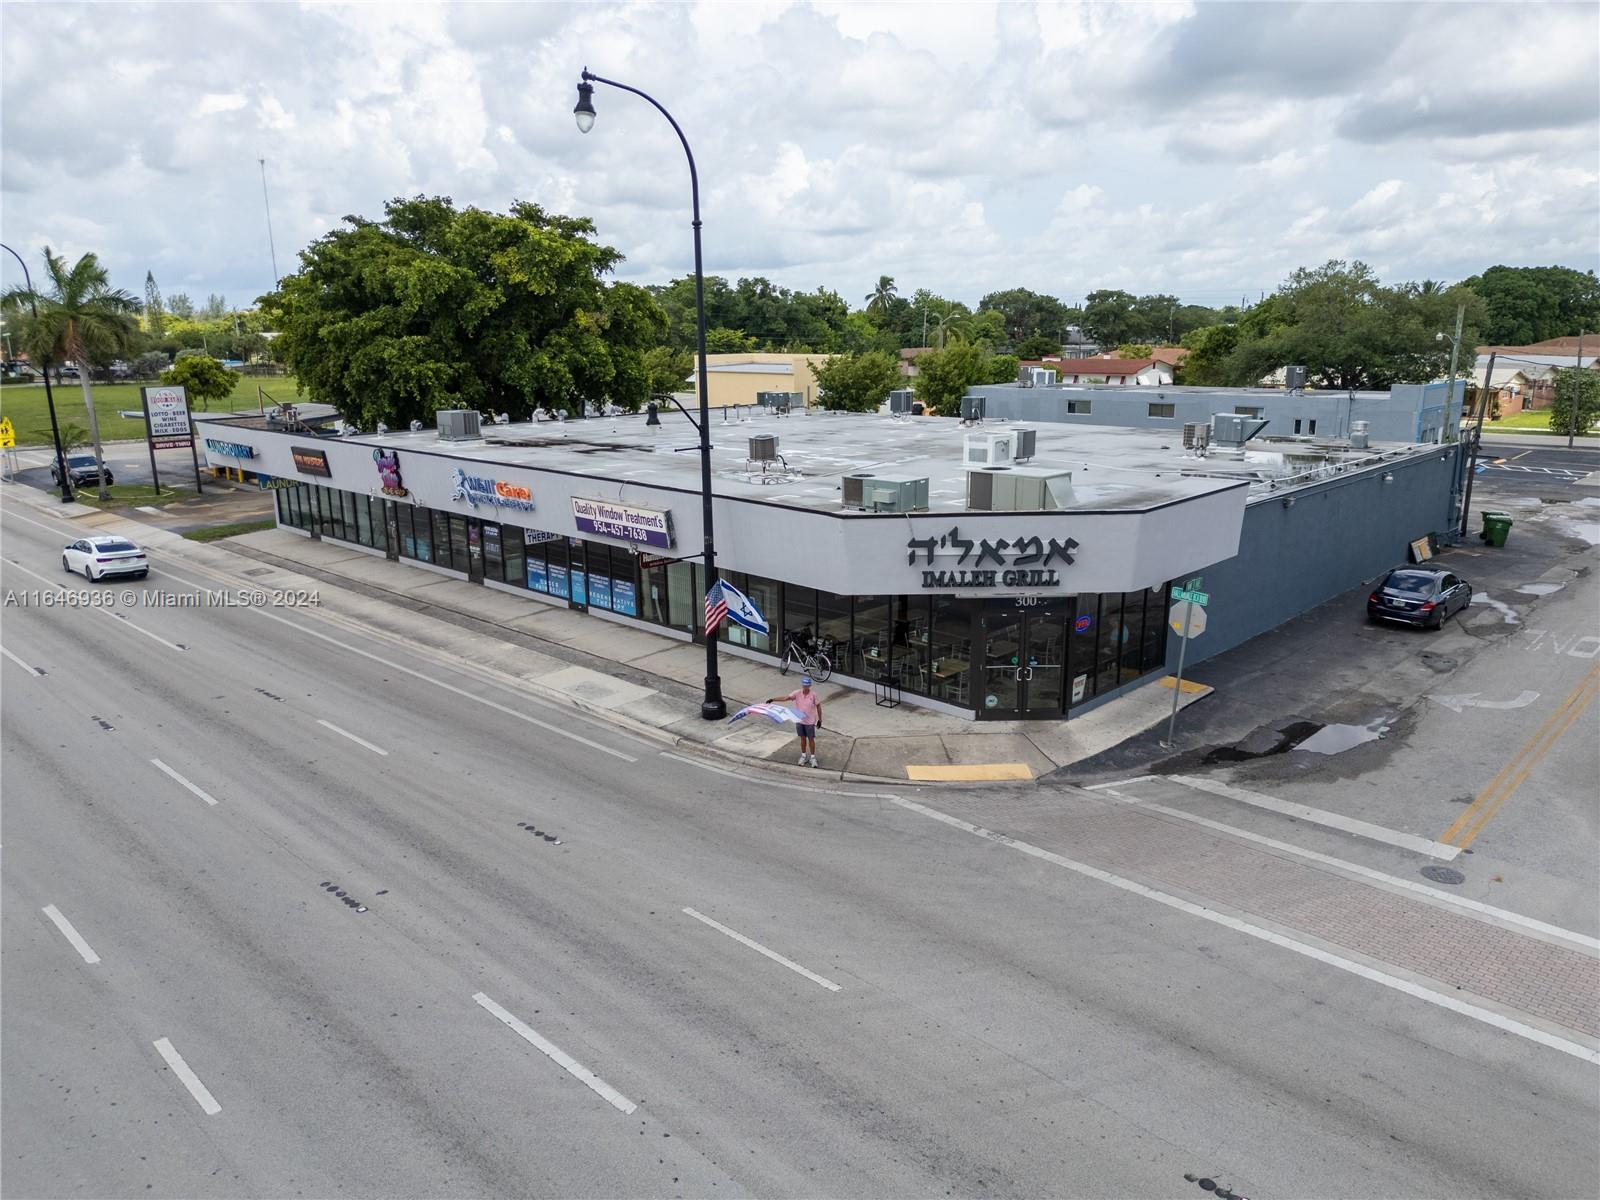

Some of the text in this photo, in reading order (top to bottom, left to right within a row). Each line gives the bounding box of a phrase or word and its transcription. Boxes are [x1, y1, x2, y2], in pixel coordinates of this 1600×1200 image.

[495, 480, 532, 502] Care
[574, 500, 664, 529] Quality Window Treatment's
[593, 520, 648, 541] 954-457-7638
[921, 569, 1060, 588] IMALEH GRILL
[1015, 596, 1037, 607] 300
